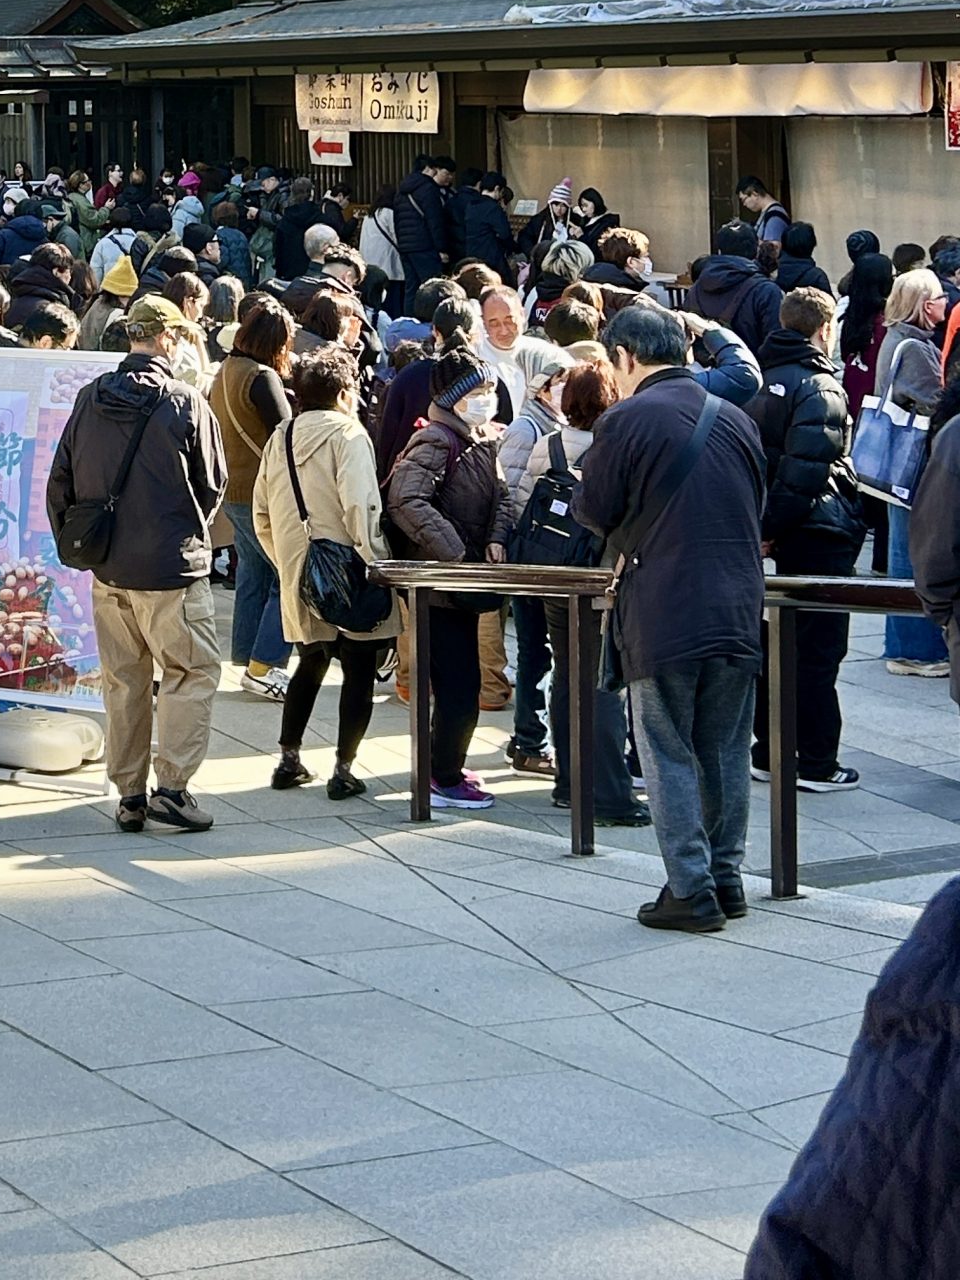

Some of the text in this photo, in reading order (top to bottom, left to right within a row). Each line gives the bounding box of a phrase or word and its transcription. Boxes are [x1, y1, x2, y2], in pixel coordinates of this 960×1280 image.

[371, 72, 430, 94] おみくじ
[369, 99, 429, 123] Omikuji
